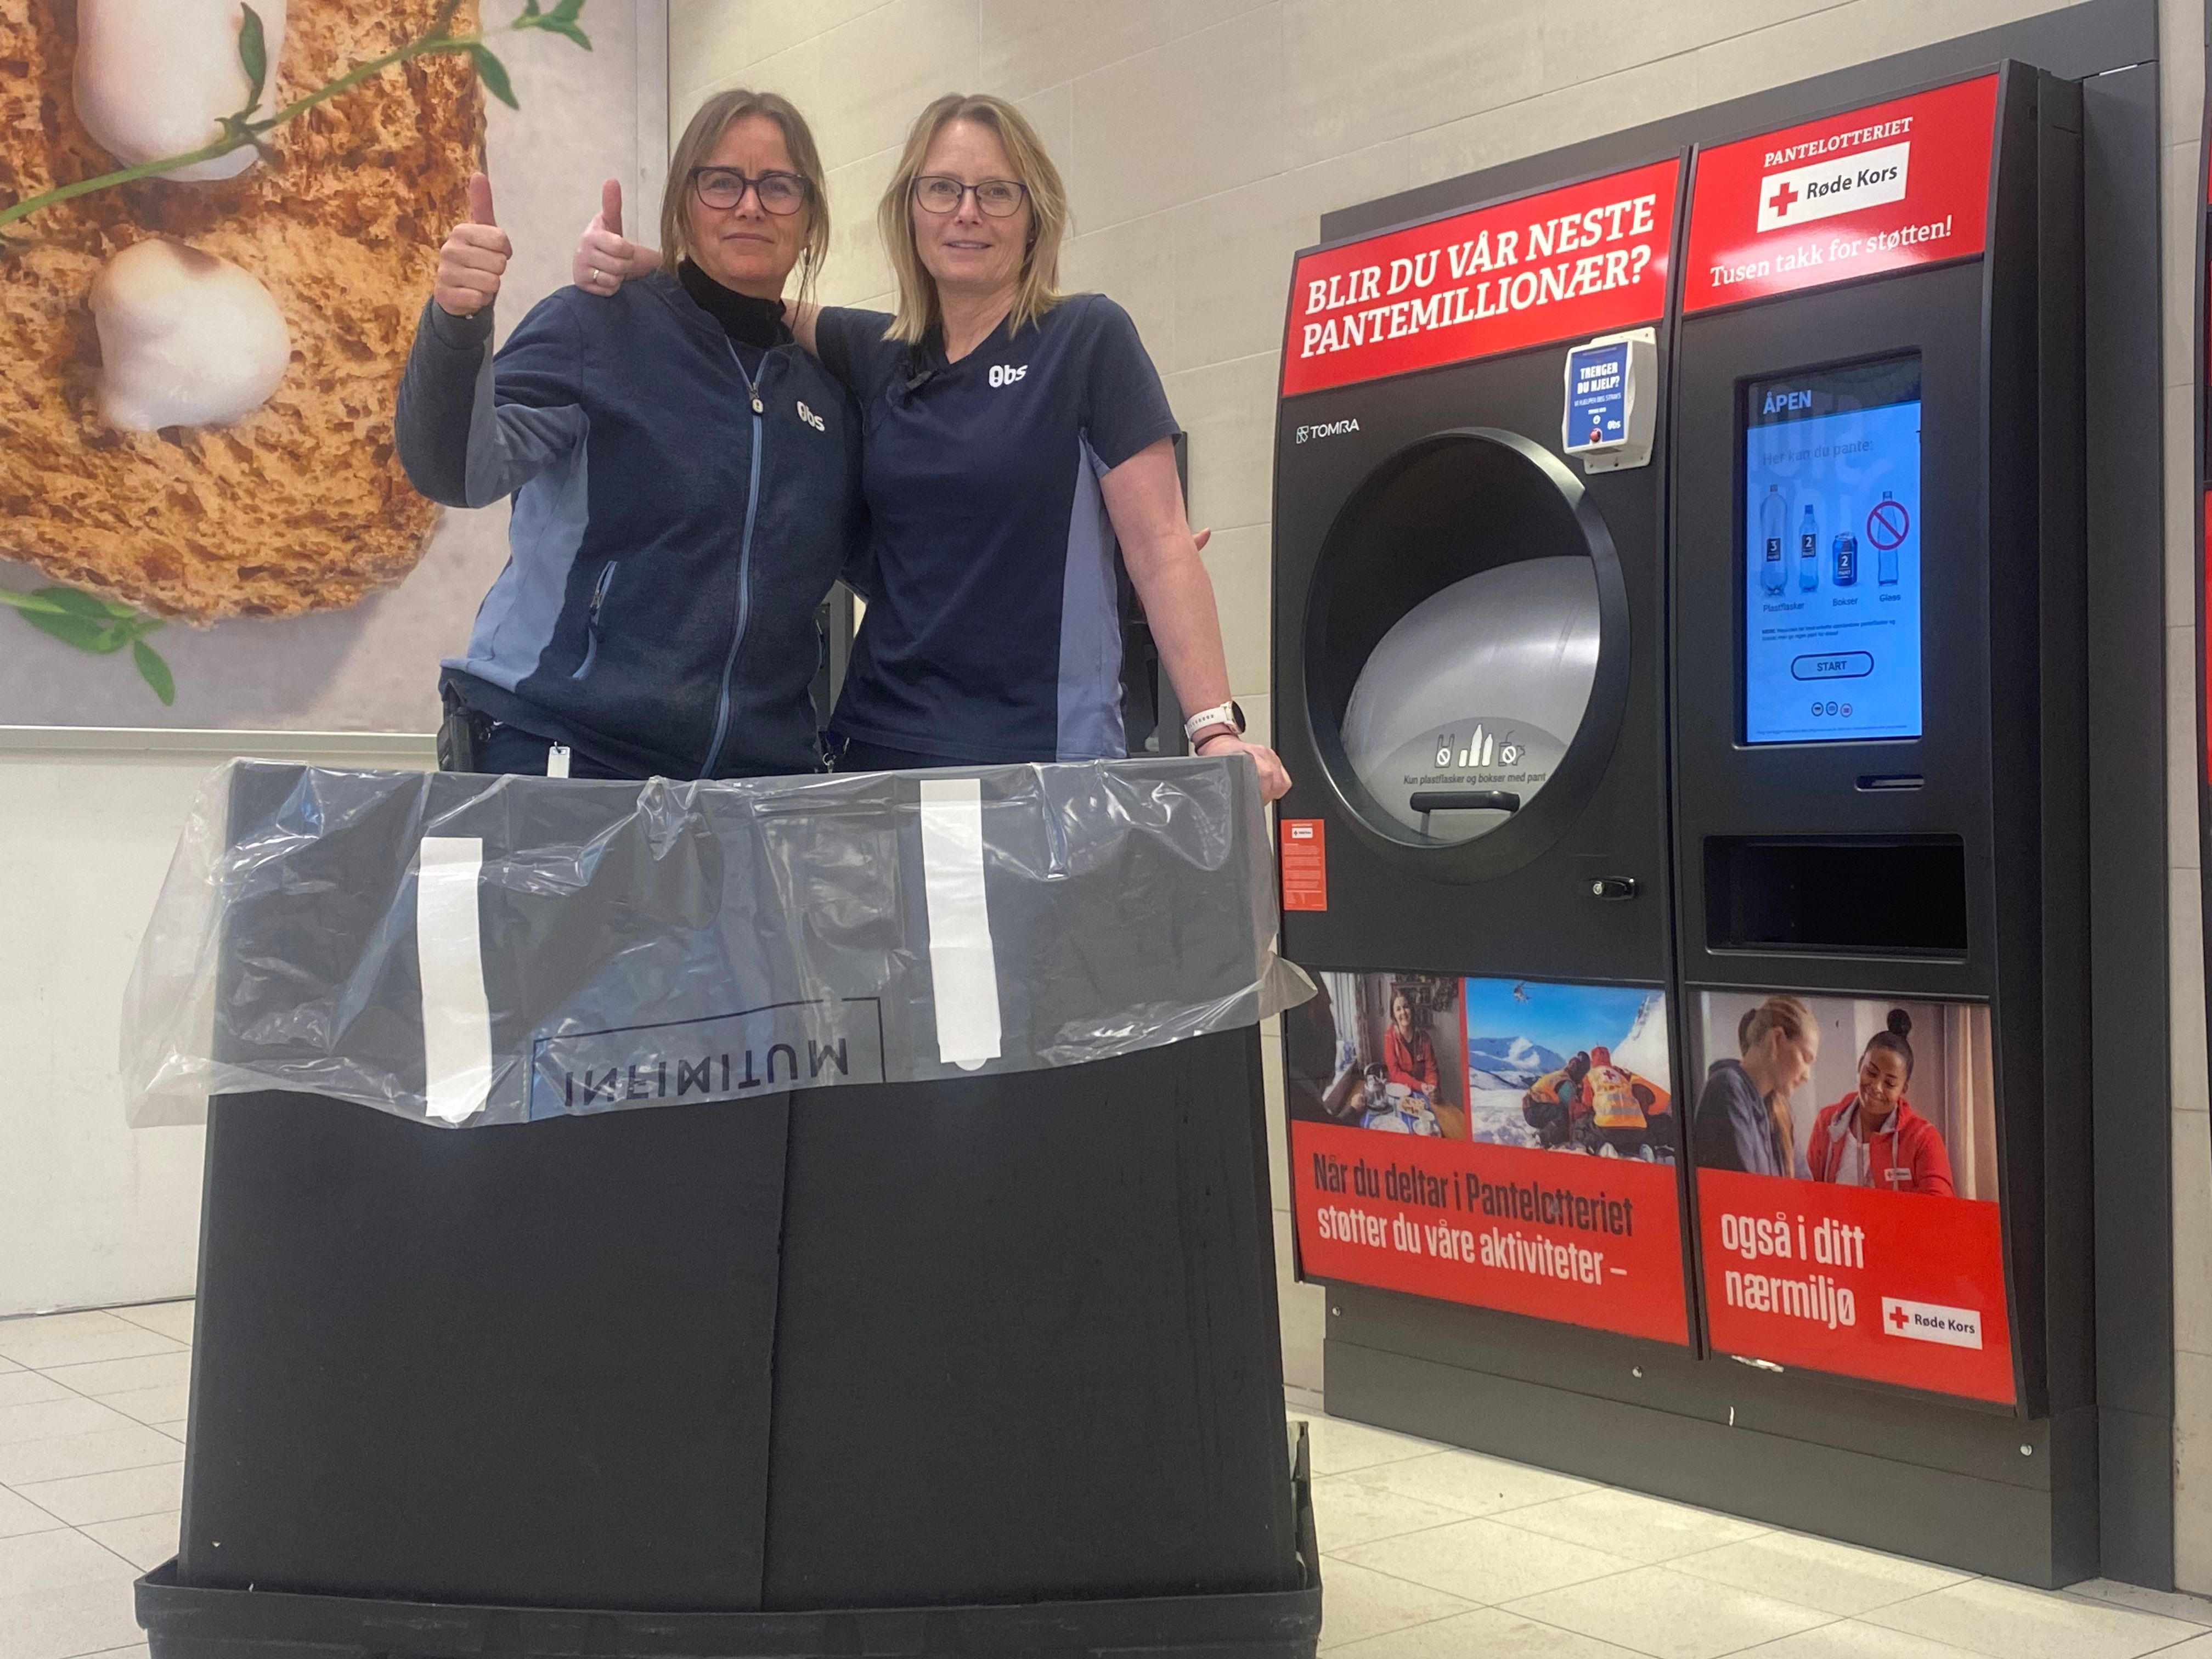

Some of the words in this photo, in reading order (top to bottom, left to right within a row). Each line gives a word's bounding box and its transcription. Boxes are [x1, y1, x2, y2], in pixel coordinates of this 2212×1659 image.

[1763, 117, 1913, 168] PANTELOTTERIET
[1807, 175, 1853, 199] Røde
[1857, 164, 1897, 188] Kors
[1305, 270, 1380, 315] BLIR
[1387, 250, 1441, 295] DU
[1447, 229, 1519, 278] VÅR
[1525, 194, 1656, 261] NESTE
[1710, 260, 1770, 287] Tusen
[1776, 244, 1824, 270] takk
[1829, 238, 1861, 262] for
[1866, 215, 1953, 253] støtten!
[1300, 244, 1651, 358] PANTEMILLIONÆR?
[989, 364, 1028, 387] Obs
[1580, 362, 1618, 380] TRENGER
[1577, 382, 1589, 394] DU
[1590, 375, 1620, 392] HJELP?
[1763, 390, 1812, 414] ÅPEN
[797, 400, 825, 431] Obs
[1310, 418, 1359, 438] TOMRA
[1763, 452, 1786, 465] Her
[1788, 449, 1810, 461] kan
[1814, 446, 1830, 458] du
[1770, 540, 1777, 551] 3
[1805, 536, 1812, 548] 2
[1841, 555, 1848, 566] 2
[1763, 602, 1804, 612] Plastflasker
[1832, 597, 1858, 606] Bokser
[1880, 594, 1901, 602] Glass
[1817, 661, 1847, 672] START
[1404, 775, 1418, 784] Kun
[1420, 774, 1464, 785] plastflasker
[1466, 776, 1476, 785] og
[1479, 774, 1505, 783] bokser
[1508, 774, 1525, 782] med
[1527, 772, 1546, 783] pant
[1313, 1153, 1346, 1193] Når
[1354, 1160, 1379, 1198] du
[1385, 1163, 1447, 1209] deltar
[1454, 1172, 1461, 1210] i
[1467, 1173, 1633, 1237] Pantelotteriet
[1318, 1205, 1387, 1249] støtter
[1393, 1212, 1420, 1254] du
[1426, 1218, 1475, 1263] våre
[1481, 1227, 1602, 1285] aktiviteter
[1721, 1212, 1792, 1260] også
[1797, 1215, 1807, 1260] i
[1814, 1217, 1865, 1269] ditt
[1725, 1270, 1856, 1329] nærmiljø
[1915, 1313, 1945, 1330] Røde
[1949, 1319, 1976, 1334] Kors
